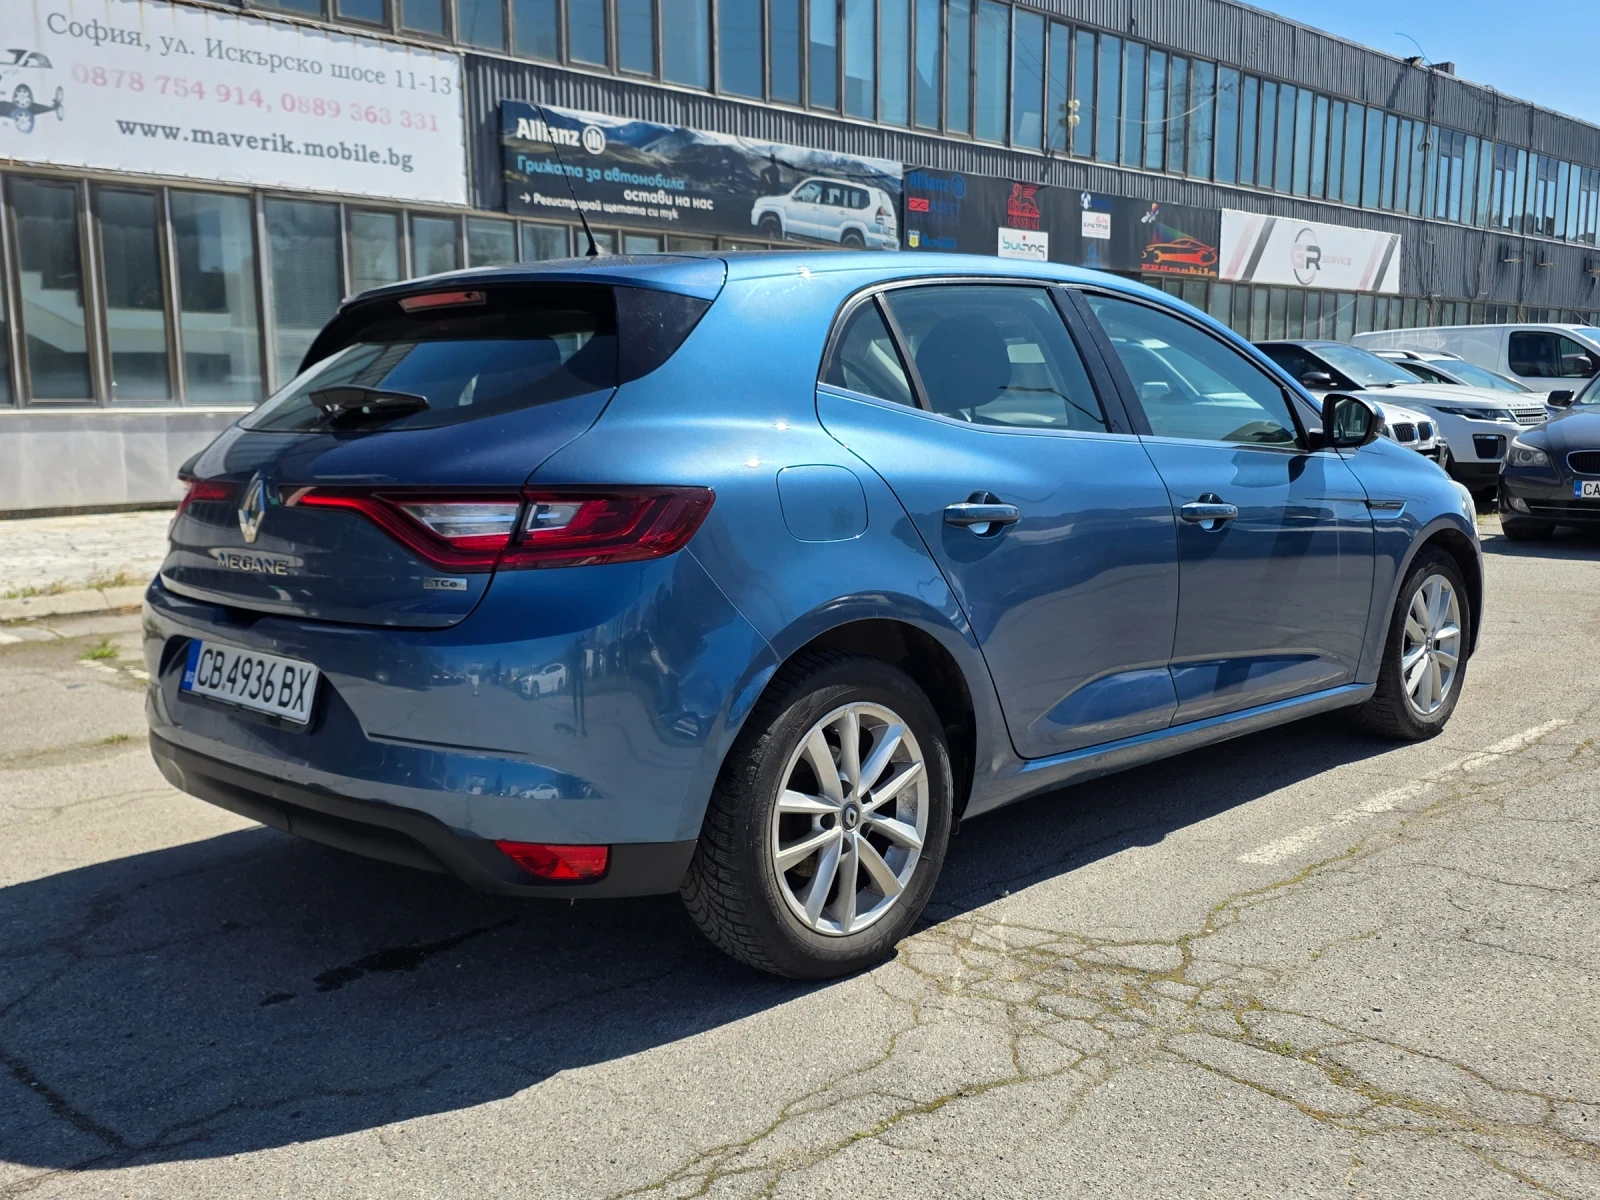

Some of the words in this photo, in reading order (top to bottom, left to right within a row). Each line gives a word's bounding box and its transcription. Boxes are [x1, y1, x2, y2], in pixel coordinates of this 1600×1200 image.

[46, 12, 151, 52] София,
[159, 35, 196, 57] ул.
[205, 37, 323, 74] Искърско
[330, 63, 387, 85] шосе
[395, 69, 452, 96] 11-13
[71, 62, 145, 92] 0878
[155, 75, 206, 101] 754
[215, 83, 273, 114] 914,
[280, 92, 341, 118] 0889
[349, 102, 392, 126] 363
[400, 110, 439, 133] 331
[116, 119, 414, 174] www.maverik.mobile.bg
[516, 117, 581, 148] Allianz
[517, 155, 584, 179] Грижата
[586, 167, 601, 182] за
[604, 167, 685, 191] автомобила
[533, 192, 602, 211] Регистрирай
[603, 202, 646, 217] щетата
[648, 208, 659, 218] си
[660, 208, 679, 221] тук
[623, 189, 673, 206] остави
[675, 196, 691, 207] на
[692, 198, 714, 211] нас
[1008, 216, 1039, 231] GENERALI
[1321, 253, 1352, 267] SERVICE
[217, 552, 289, 576] MEGANE
[432, 578, 457, 588] TCe
